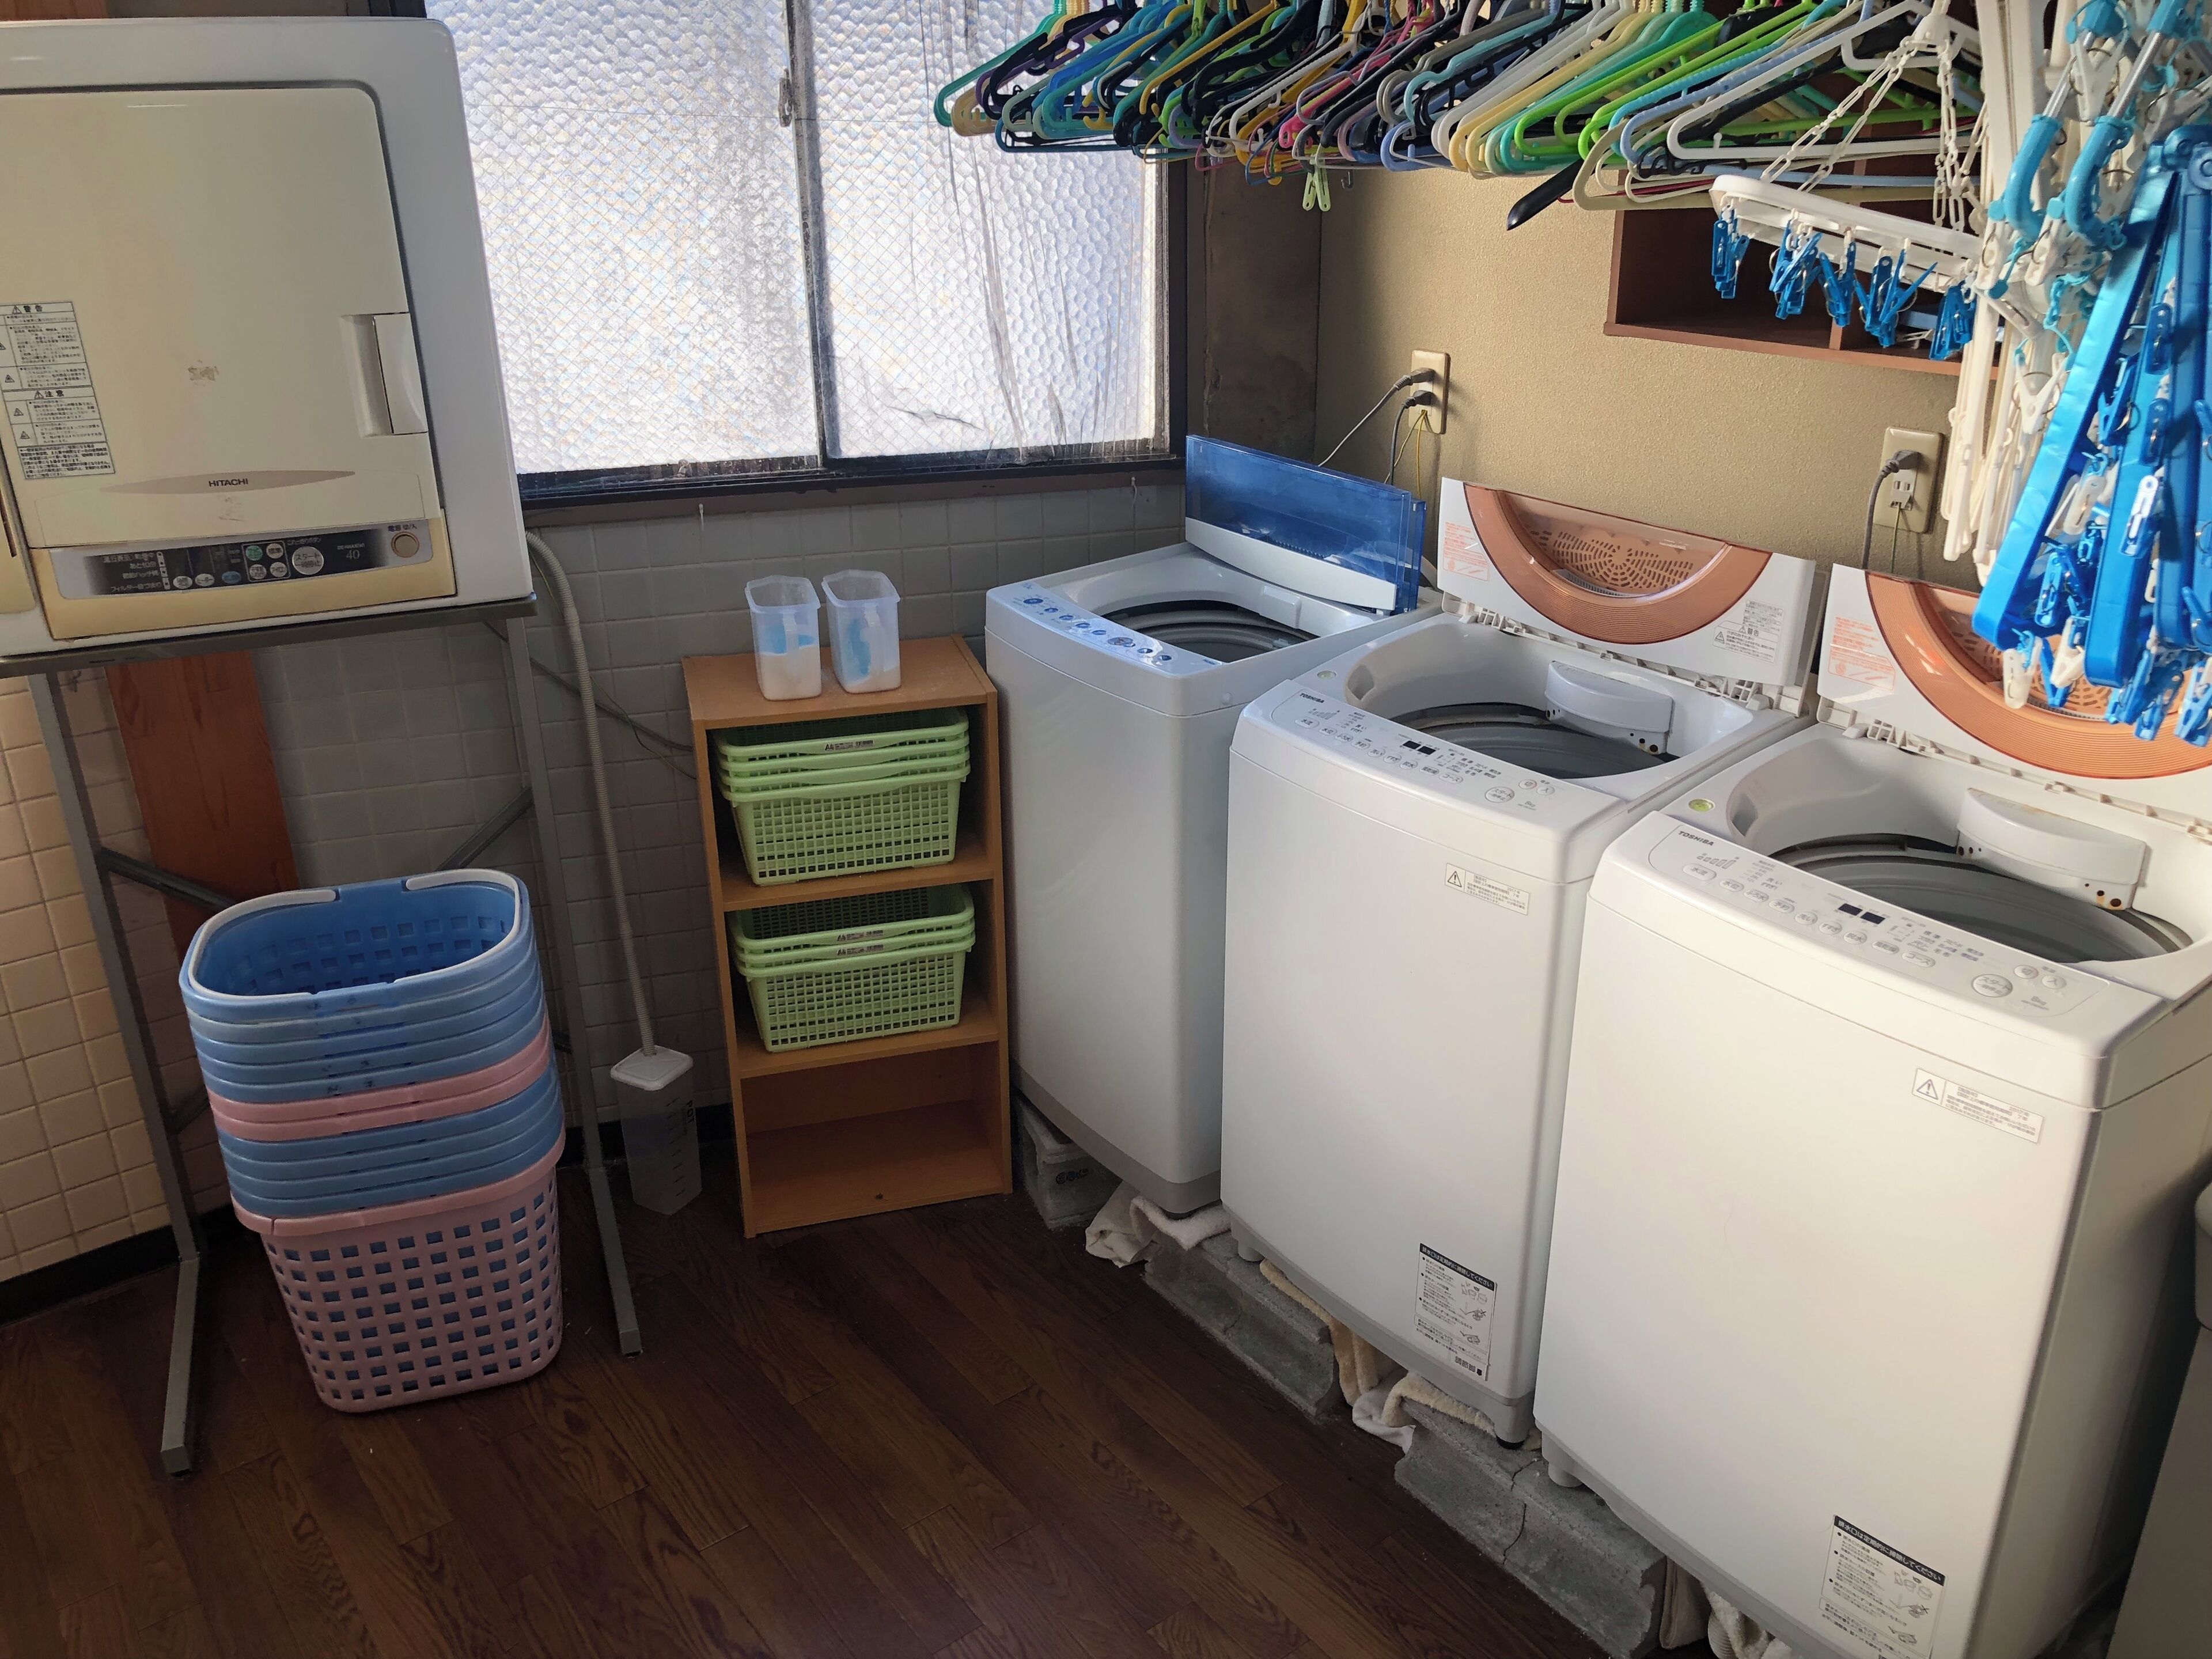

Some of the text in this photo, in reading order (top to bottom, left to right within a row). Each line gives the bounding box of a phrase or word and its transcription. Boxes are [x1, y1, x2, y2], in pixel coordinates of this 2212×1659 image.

[208, 478, 249, 487] HITACHI
[295, 552, 321, 561] スタート
[346, 549, 361, 560] 40
[1300, 693, 1325, 703] TOSHIBA
[1442, 774, 1460, 782] コース
[1491, 788, 1513, 798] スタート
[1678, 830, 1714, 846] TOSHIBA
[1773, 901, 1790, 911] 予約
[1797, 913, 1815, 923] 洗い
[1845, 932, 1863, 943] 脱水
[1905, 952, 1930, 965] コース
[1979, 976, 2011, 991] スタート
[2046, 978, 2058, 986] 入
